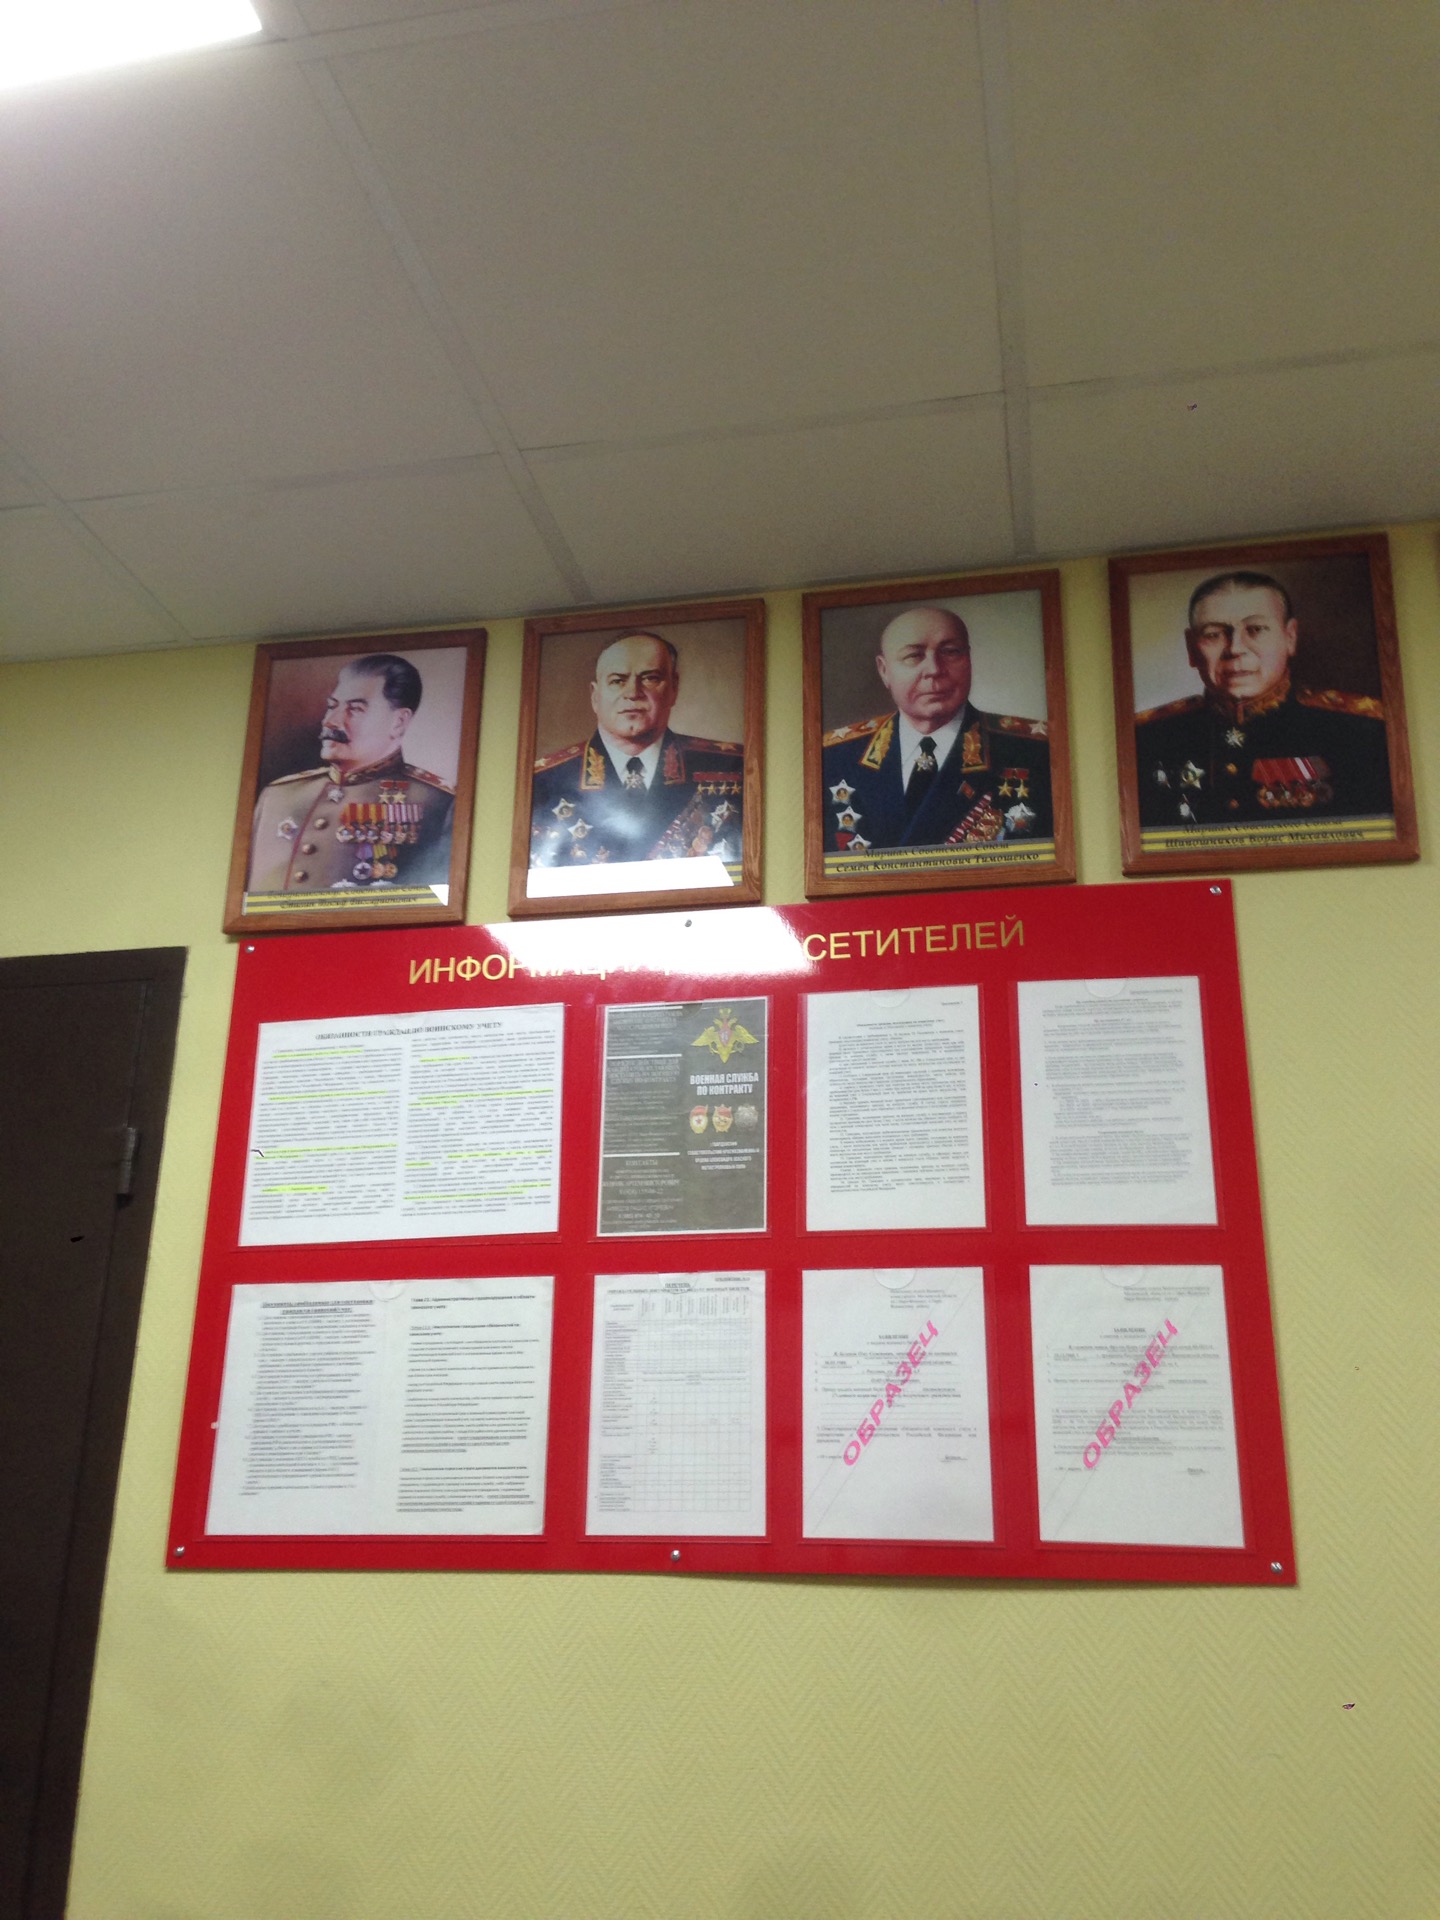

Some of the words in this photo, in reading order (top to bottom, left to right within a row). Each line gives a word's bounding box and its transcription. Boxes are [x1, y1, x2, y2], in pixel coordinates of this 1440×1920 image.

[863, 848, 908, 859] Маршал
[910, 844, 973, 856] Советского
[974, 841, 1009, 852] Союза
[873, 857, 971, 871] Константинович
[974, 852, 1041, 865] Тимошенко
[802, 914, 1025, 961] СЕТИТЕЛЕЙ
[690, 1074, 725, 1085] ВОЕННАЯ
[726, 1072, 759, 1083] СЛУЖБА
[697, 1085, 708, 1096] ПО
[709, 1083, 753, 1095] КОНТРАКТУ
[843, 1320, 939, 1466] ОБРАЗЕЦ
[1083, 1318, 1180, 1469] ОБРАЗЕЦ
